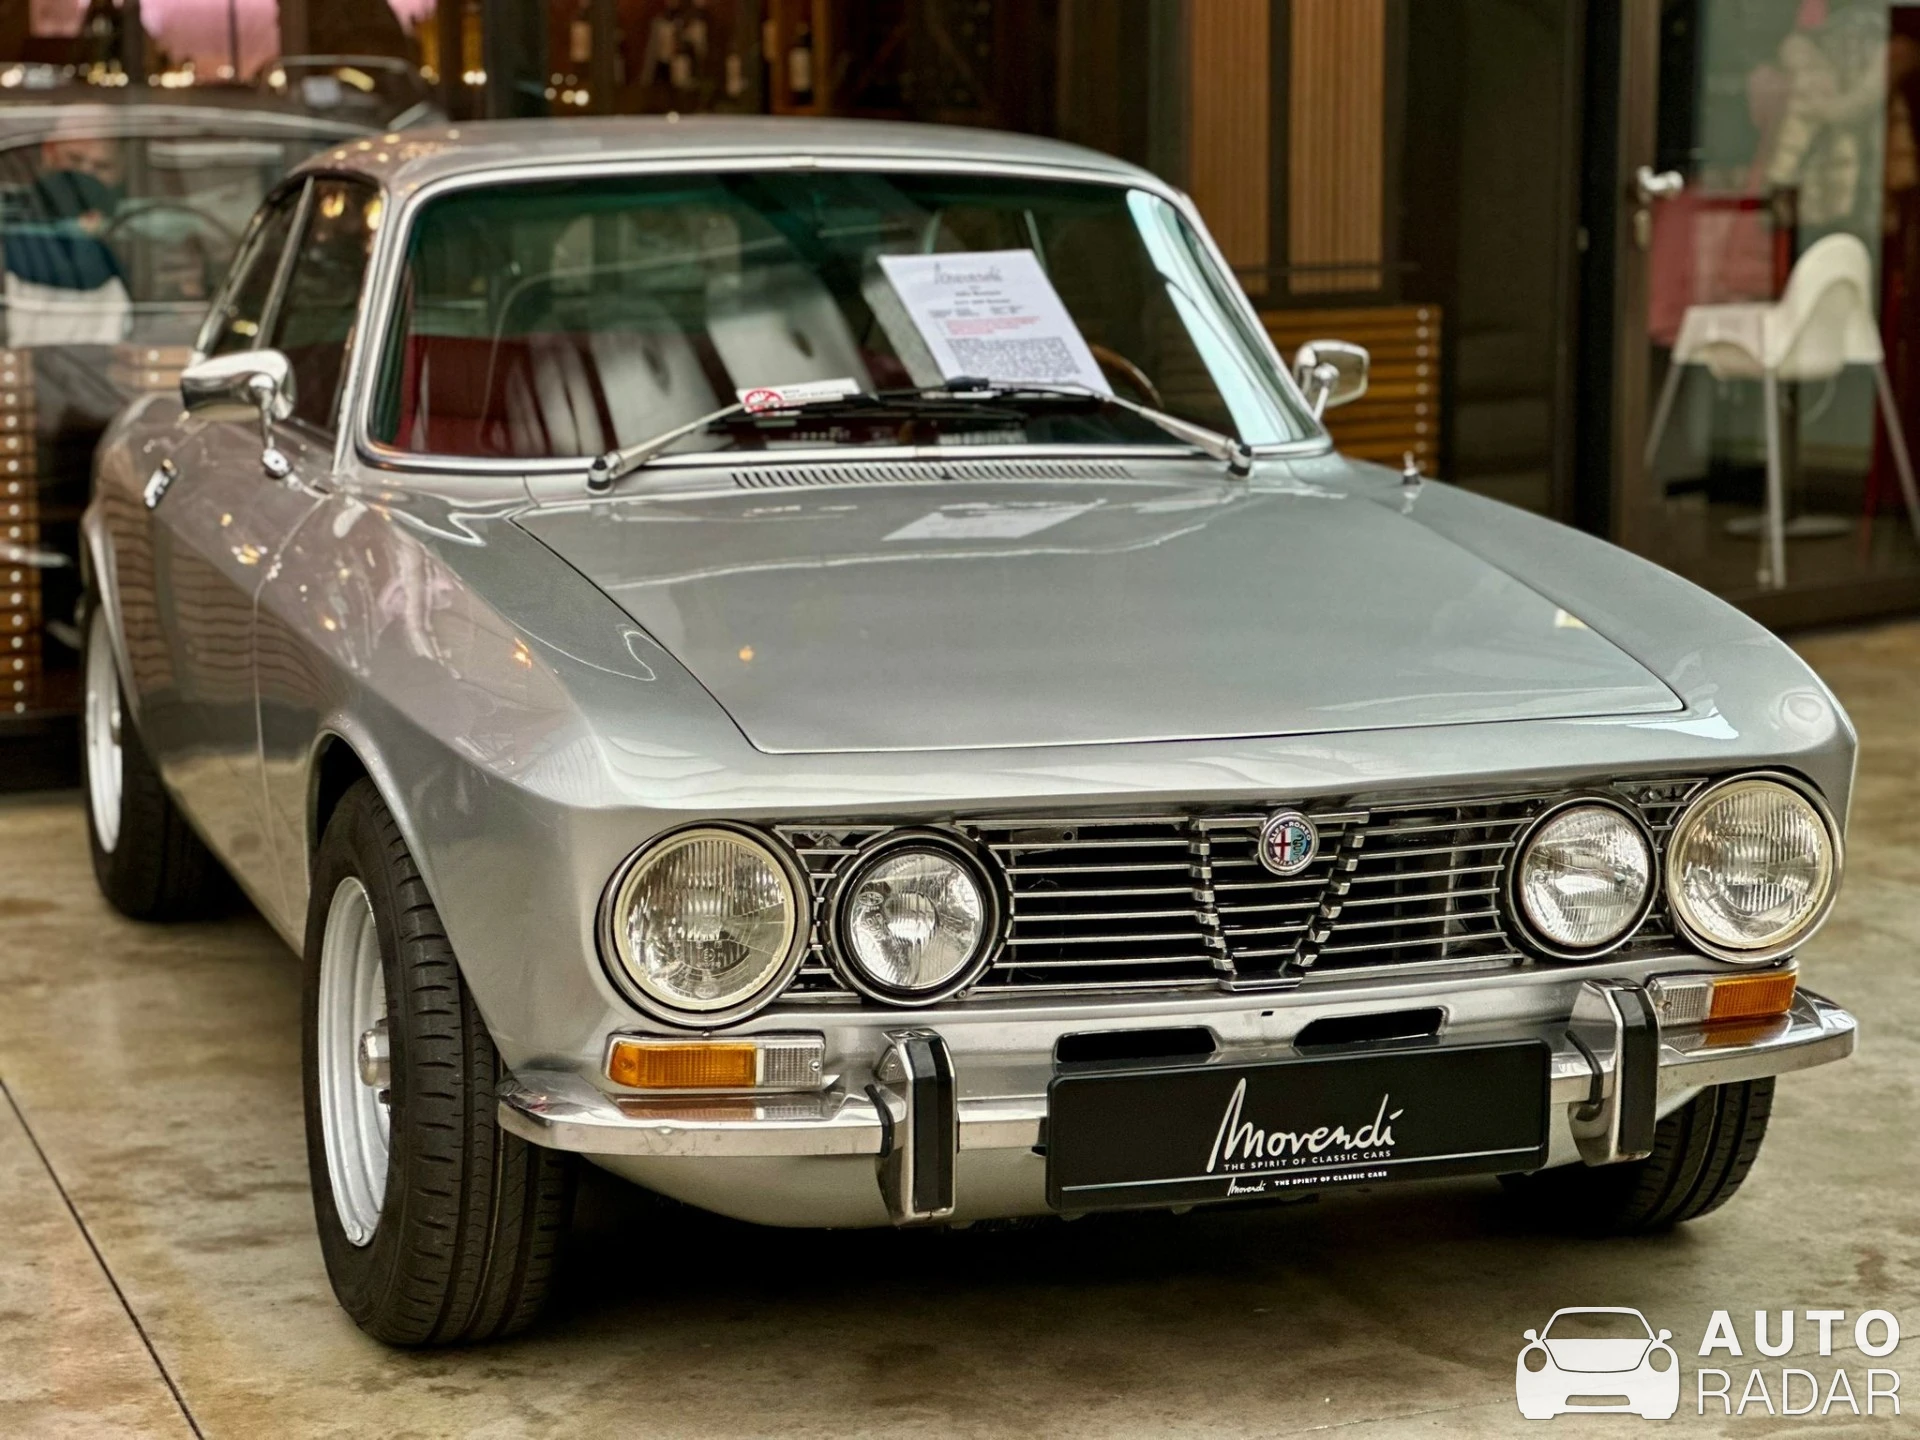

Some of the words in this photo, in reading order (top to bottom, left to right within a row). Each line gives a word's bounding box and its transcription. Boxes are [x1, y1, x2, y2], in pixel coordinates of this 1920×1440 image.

[1273, 855, 1305, 866] MILANO
[1206, 1077, 1404, 1173] Movendi
[1224, 1162, 1246, 1172] THE
[1250, 1158, 1288, 1170] SPIRIT
[1292, 1157, 1307, 1166] OF
[1311, 1152, 1359, 1164] CLASSIC
[1363, 1149, 1392, 1160] CARS
[1226, 1176, 1267, 1197] Movendi
[1274, 1179, 1290, 1187] THE
[1292, 1176, 1318, 1185] SPIRIT
[1320, 1175, 1331, 1183] OF
[1333, 1172, 1366, 1181] CLASSIC
[1367, 1170, 1388, 1179] CARS
